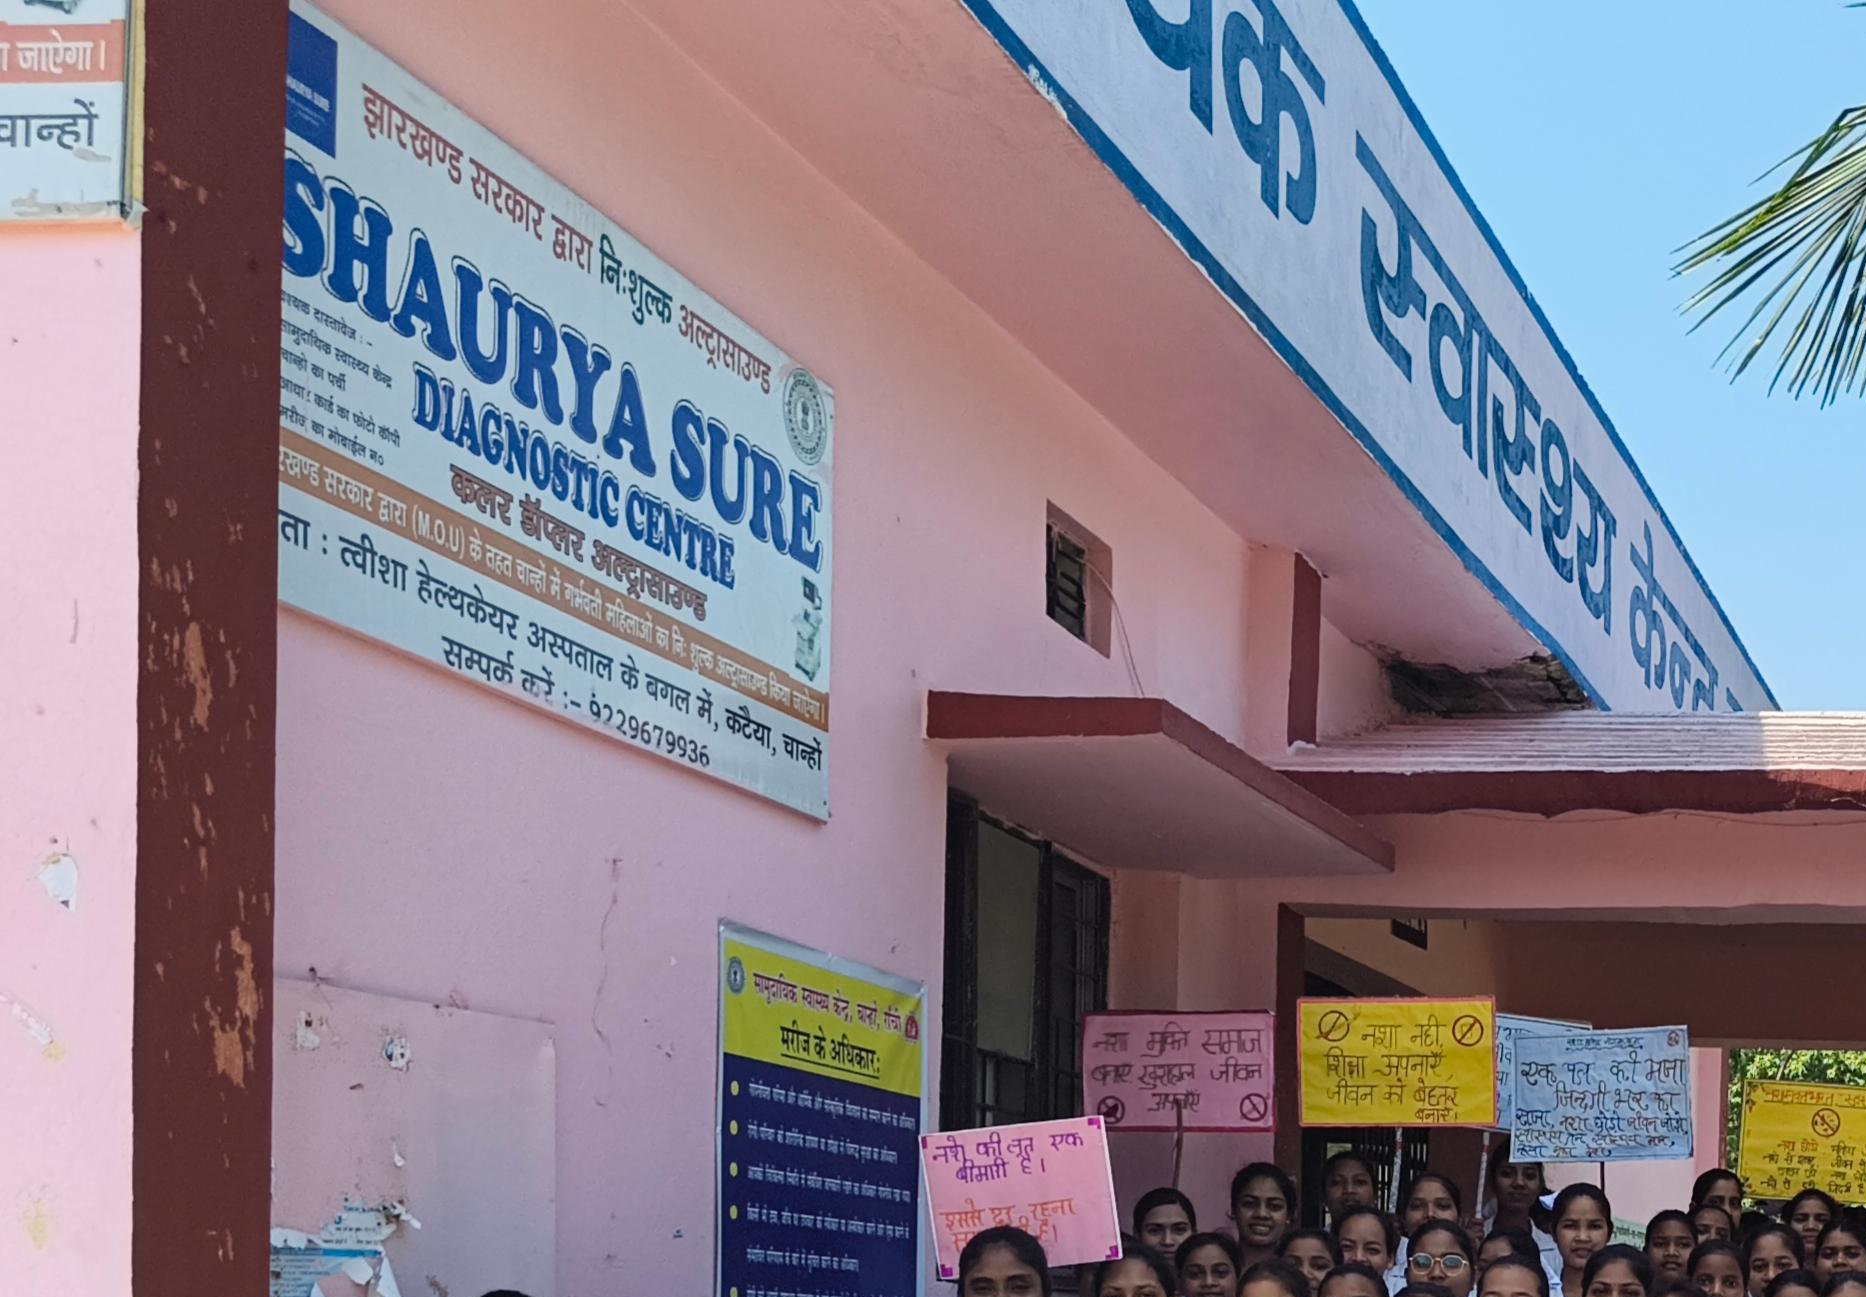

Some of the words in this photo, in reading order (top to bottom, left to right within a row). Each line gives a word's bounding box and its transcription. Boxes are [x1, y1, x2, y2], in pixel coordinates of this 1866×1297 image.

[361, 82, 464, 185] झारखण्ड
[469, 157, 545, 241] सरकार
[551, 213, 594, 274] द्वारा
[678, 304, 772, 395] अल्ट्रासाउण्ड
[282, 147, 657, 478] SHAURYA
[670, 399, 824, 574] SURE
[411, 361, 620, 529] DIAGNOSTIC
[625, 484, 737, 591] CENTRE
[324, 466, 374, 511] सरकार
[377, 493, 407, 528] द्वारा
[412, 504, 466, 561] (M.O.U)
[469, 527, 484, 564] के
[486, 543, 513, 579] तहत
[549, 570, 561, 601] में
[656, 625, 670, 651] का
[449, 463, 513, 526] कलर
[591, 538, 708, 622] अल्ट्रासाउण्ड
[278, 510, 311, 550] ता
[339, 532, 409, 592] त्वीशा
[416, 558, 519, 640] हेल्थकेयर
[527, 621, 613, 683] अस्पताल
[620, 653, 641, 692] के
[645, 672, 692, 715] बगल
[782, 736, 823, 771] चान्हों
[442, 635, 514, 683] सम्पर्क
[780, 1019, 811, 1052] मरीज
[813, 1025, 826, 1060] के
[1202, 1029, 1264, 1055] समाज
[1362, 1024, 1403, 1050] नशा
[1327, 1078, 1379, 1106] जीवन
[976, 1131, 1002, 1158] की
[1049, 1132, 1084, 1151] एक
